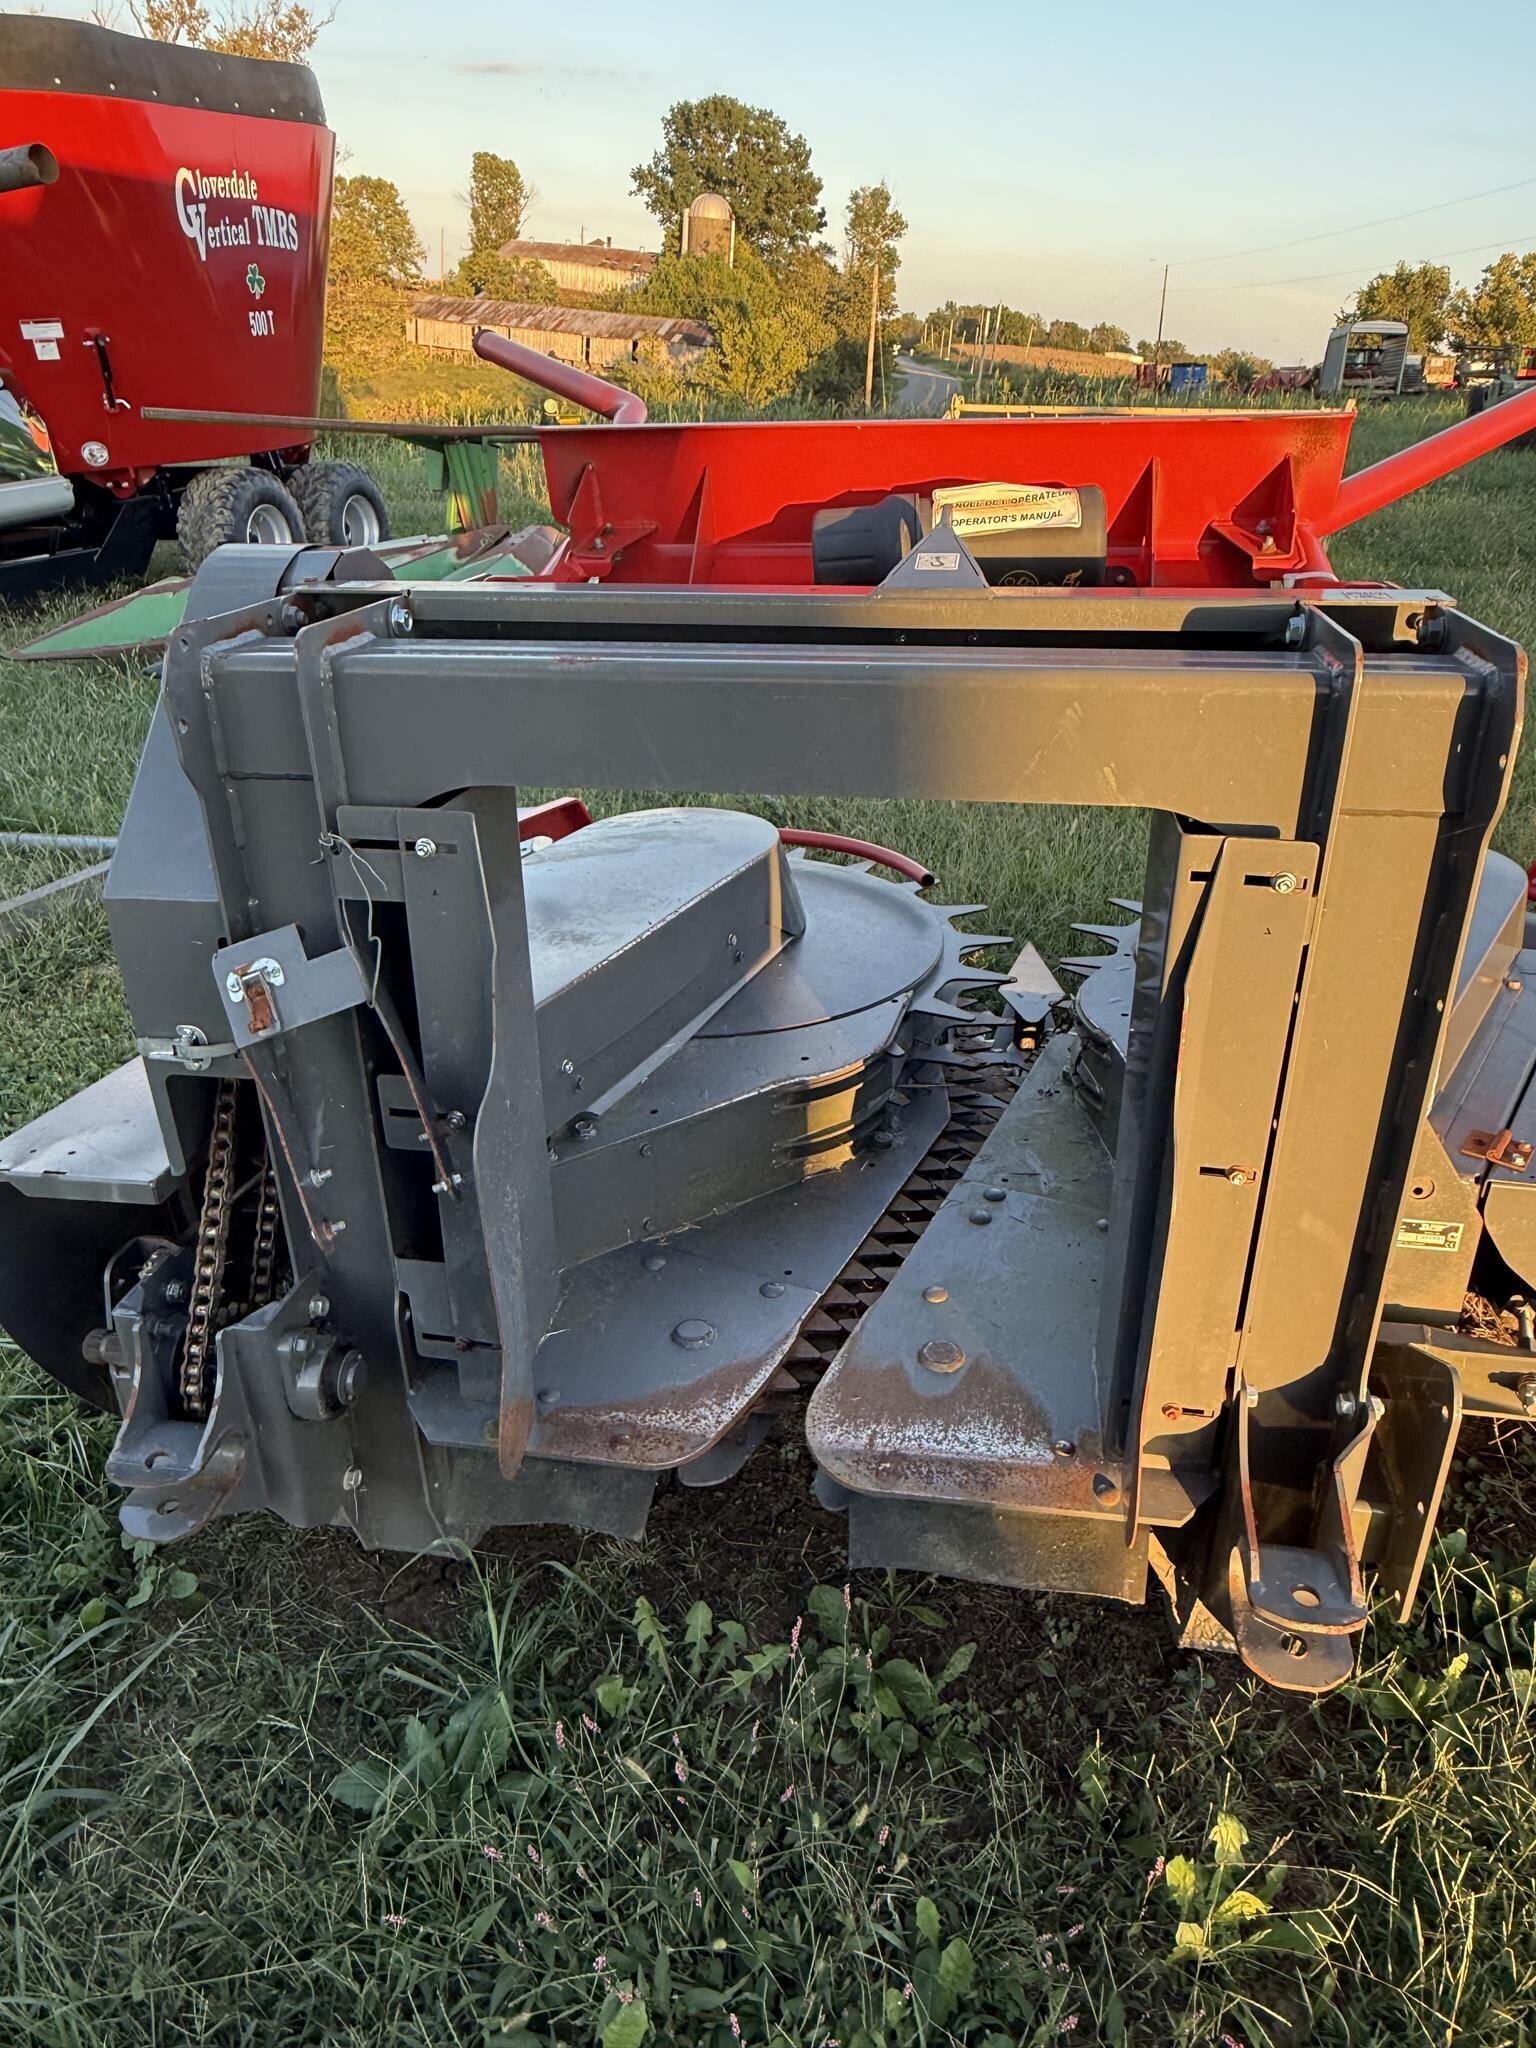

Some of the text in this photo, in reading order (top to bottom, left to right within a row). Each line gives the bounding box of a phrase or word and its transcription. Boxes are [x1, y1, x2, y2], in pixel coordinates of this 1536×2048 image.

[251, 205, 299, 251] TMRS
[951, 509, 1063, 527] OPERATOR'S MANUAL
